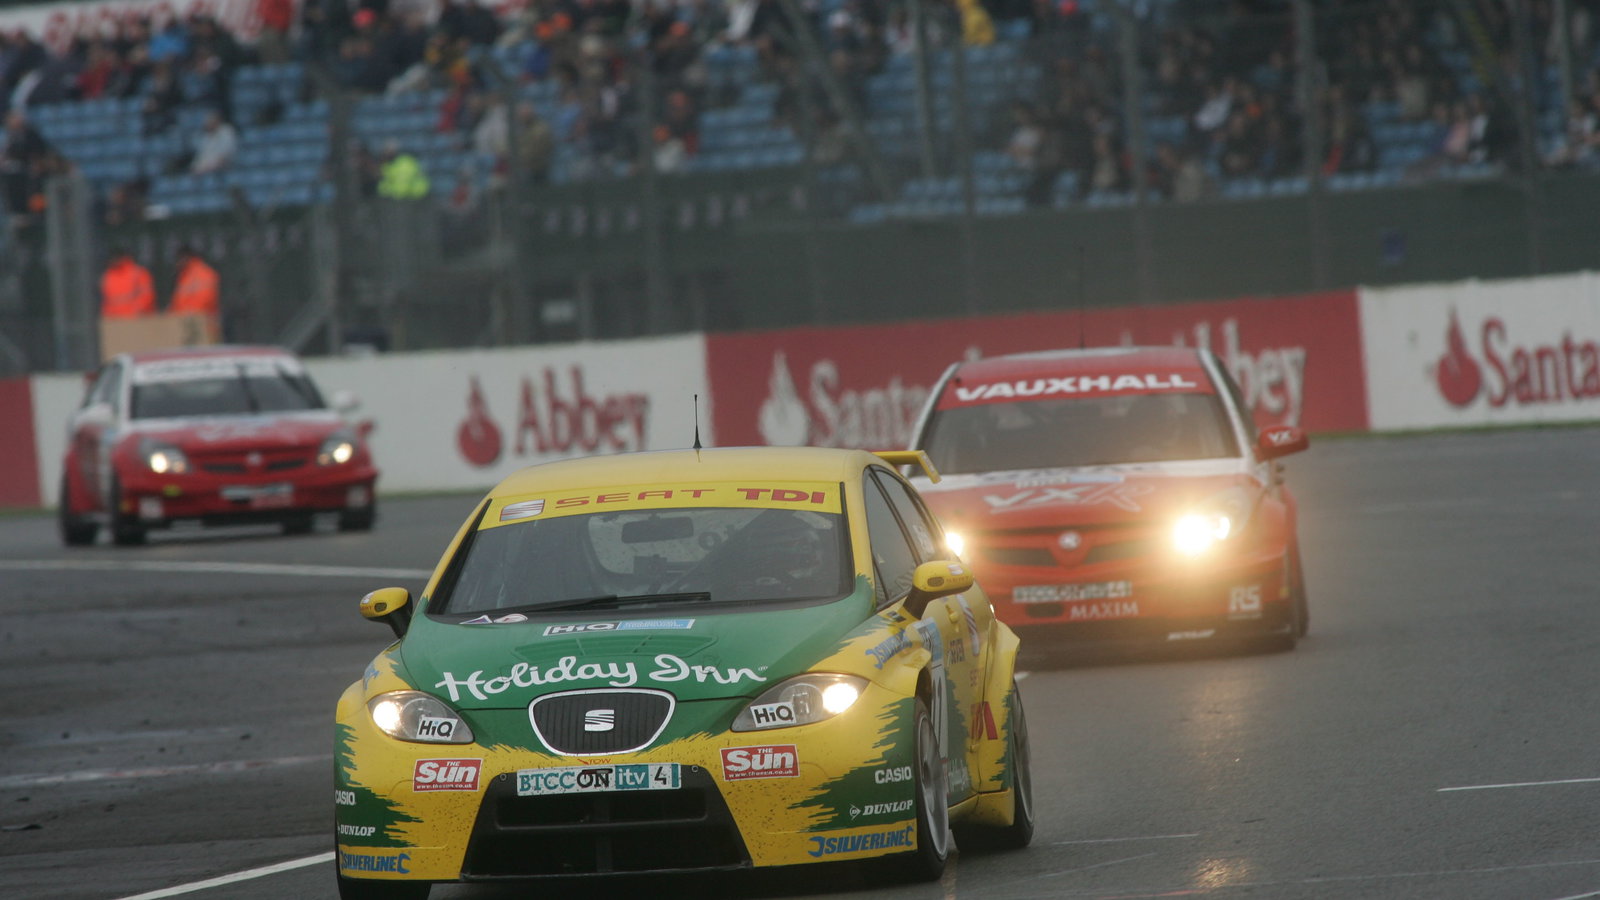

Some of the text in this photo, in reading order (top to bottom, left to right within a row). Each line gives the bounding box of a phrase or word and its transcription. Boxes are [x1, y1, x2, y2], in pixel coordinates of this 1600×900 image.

[1481, 317, 1600, 408] Santa
[955, 374, 1197, 400] VAUXHALL
[515, 365, 649, 456] Abbey
[555, 488, 825, 509] SEAT TDI
[1071, 601, 1138, 619] MAXIM
[435, 653, 767, 702] Holiday Inn
[754, 704, 793, 724] HiQ
[419, 720, 453, 737] HiQ
[726, 750, 794, 772] Sun
[415, 762, 477, 783] Sun
[618, 768, 646, 786] itv
[654, 766, 667, 785] 4
[875, 765, 912, 784] CASIO
[335, 789, 356, 806] CASIO
[862, 800, 914, 816] DUNLOP
[340, 824, 376, 836] DUNLOP
